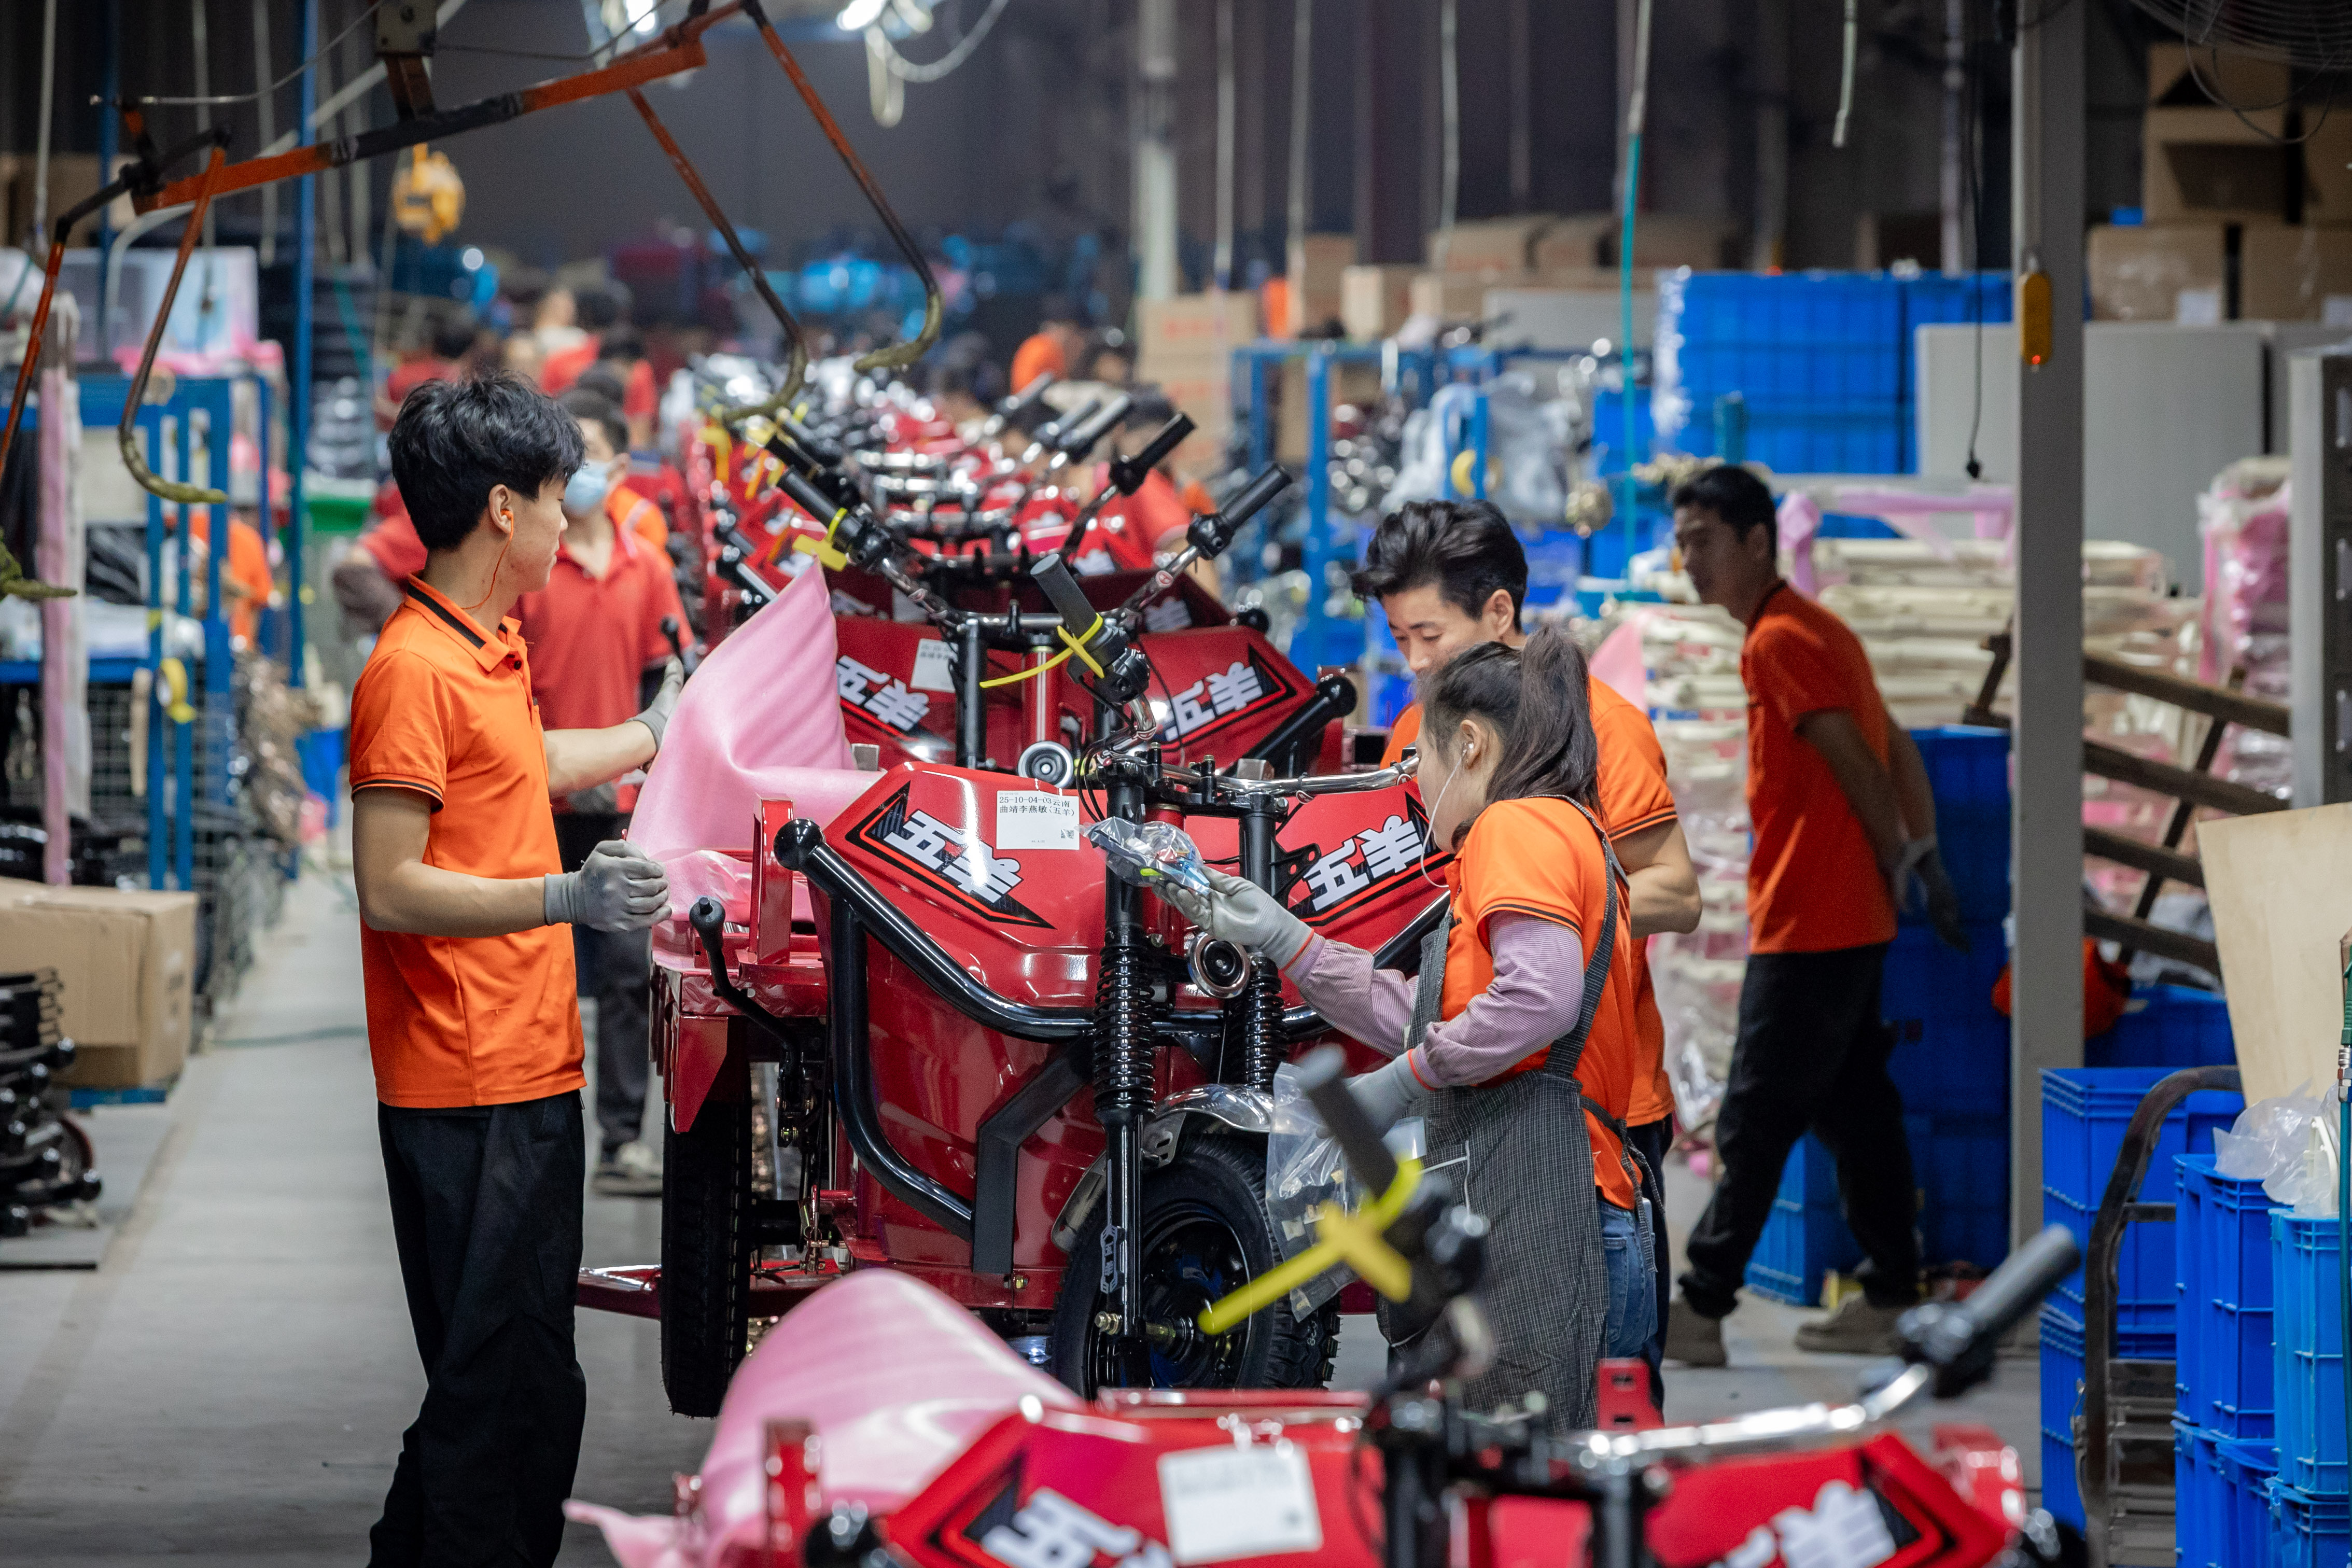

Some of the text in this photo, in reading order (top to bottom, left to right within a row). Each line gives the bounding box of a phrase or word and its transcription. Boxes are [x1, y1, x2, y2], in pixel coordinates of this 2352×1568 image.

[836, 654, 930, 731] 五羊
[1165, 661, 1263, 742] 五羊
[883, 809, 1023, 903] 五羊
[1303, 815, 1424, 912] 五羊
